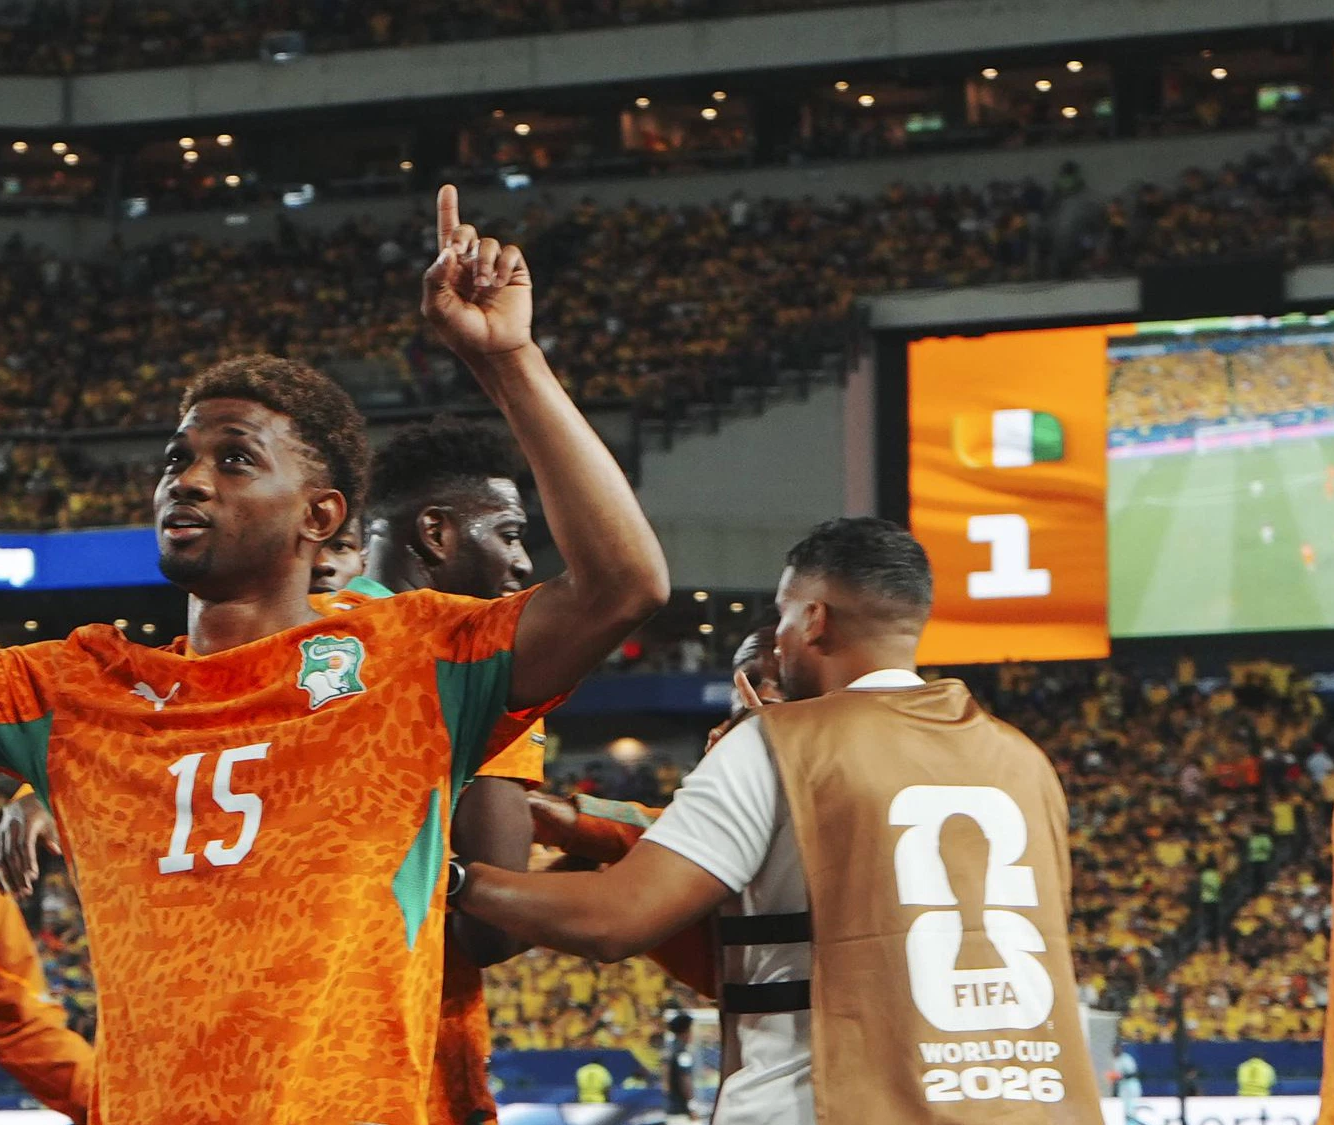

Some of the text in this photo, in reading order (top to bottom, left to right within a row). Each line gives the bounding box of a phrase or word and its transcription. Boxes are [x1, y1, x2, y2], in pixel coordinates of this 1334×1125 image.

[967, 513, 1051, 599] 1
[158, 742, 272, 875] 15
[953, 981, 1020, 1008] FIFA
[919, 1039, 1061, 1063] WORLD CUP
[922, 1066, 1065, 1103] 2026
